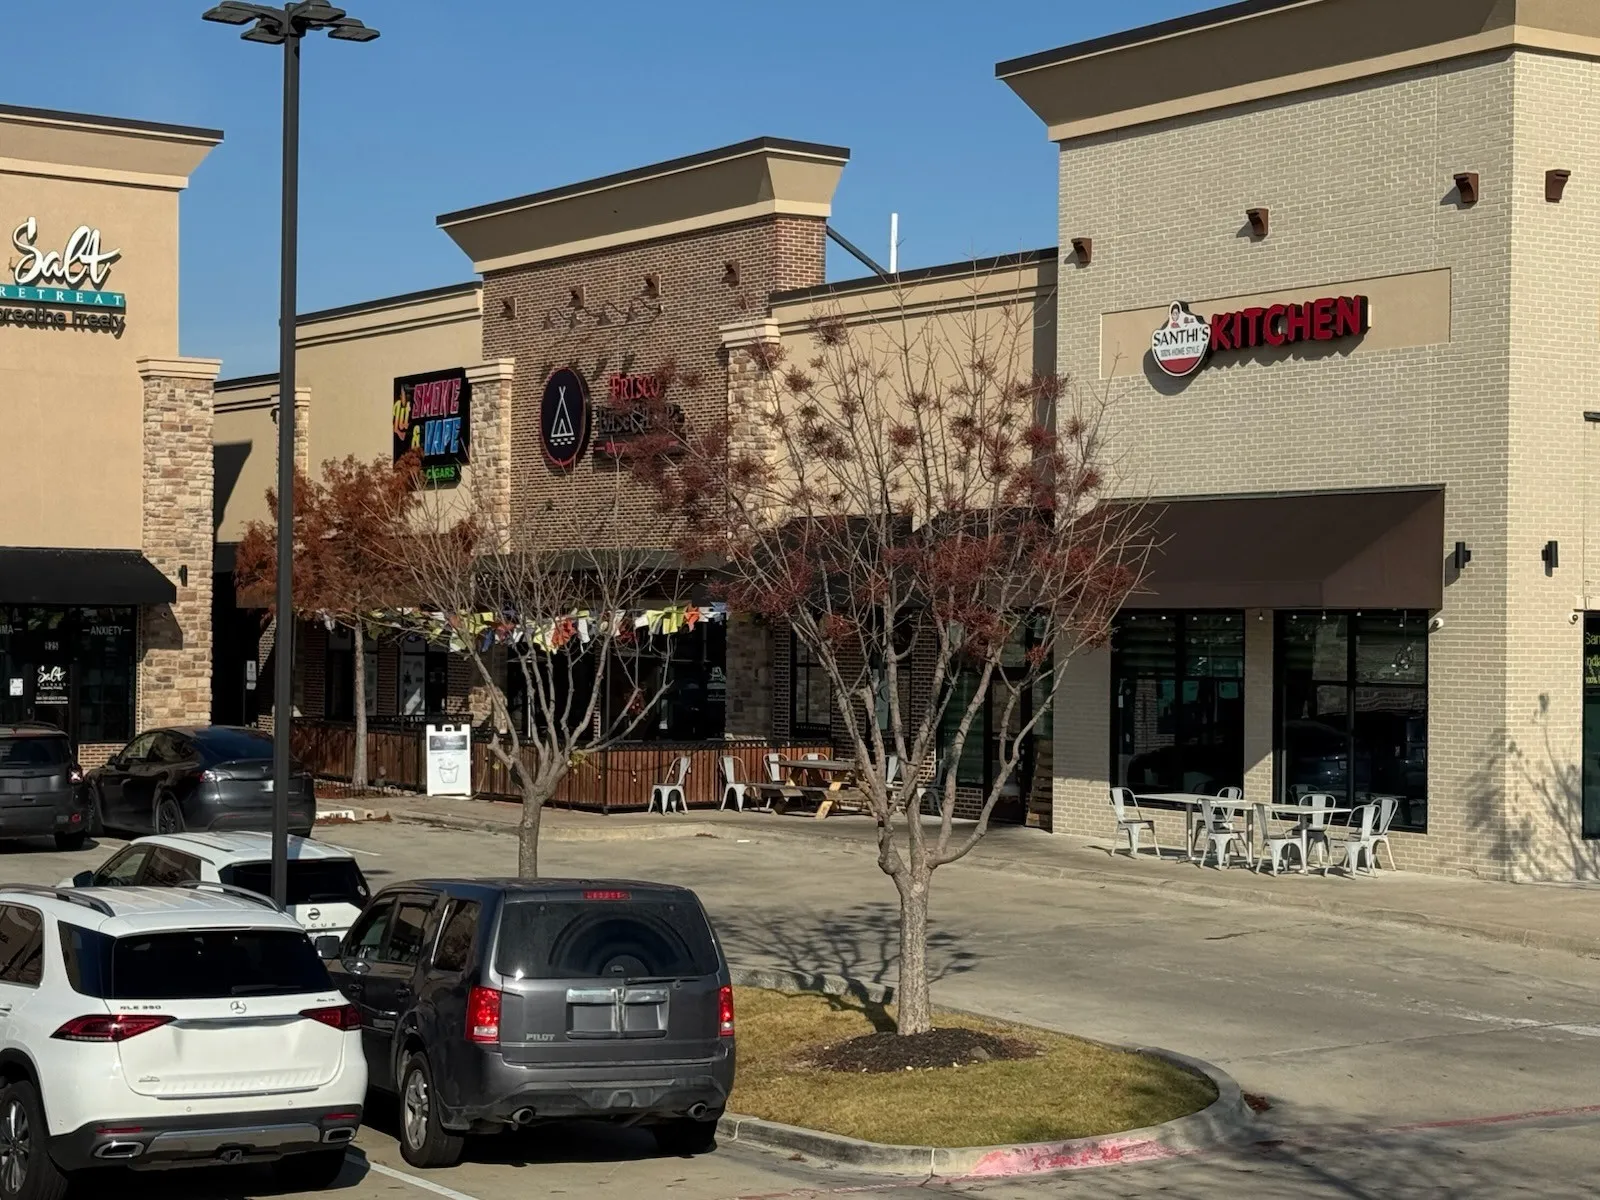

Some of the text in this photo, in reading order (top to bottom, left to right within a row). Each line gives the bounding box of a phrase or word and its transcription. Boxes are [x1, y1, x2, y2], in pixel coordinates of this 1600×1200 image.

[12, 216, 121, 284] Salt
[0, 286, 123, 306] RETREAT
[72, 310, 125, 337] freely
[1153, 295, 1367, 350] SANTHI'S KITCHEN
[1172, 347, 1185, 356] HOME
[1186, 345, 1200, 355] STYLE
[411, 377, 462, 420] SMOKE
[411, 416, 462, 457] & VAPE
[425, 466, 456, 480] CIGARS
[90, 626, 123, 635] ANXIETY
[37, 665, 66, 683] Salt
[526, 1033, 556, 1041] PILOT
